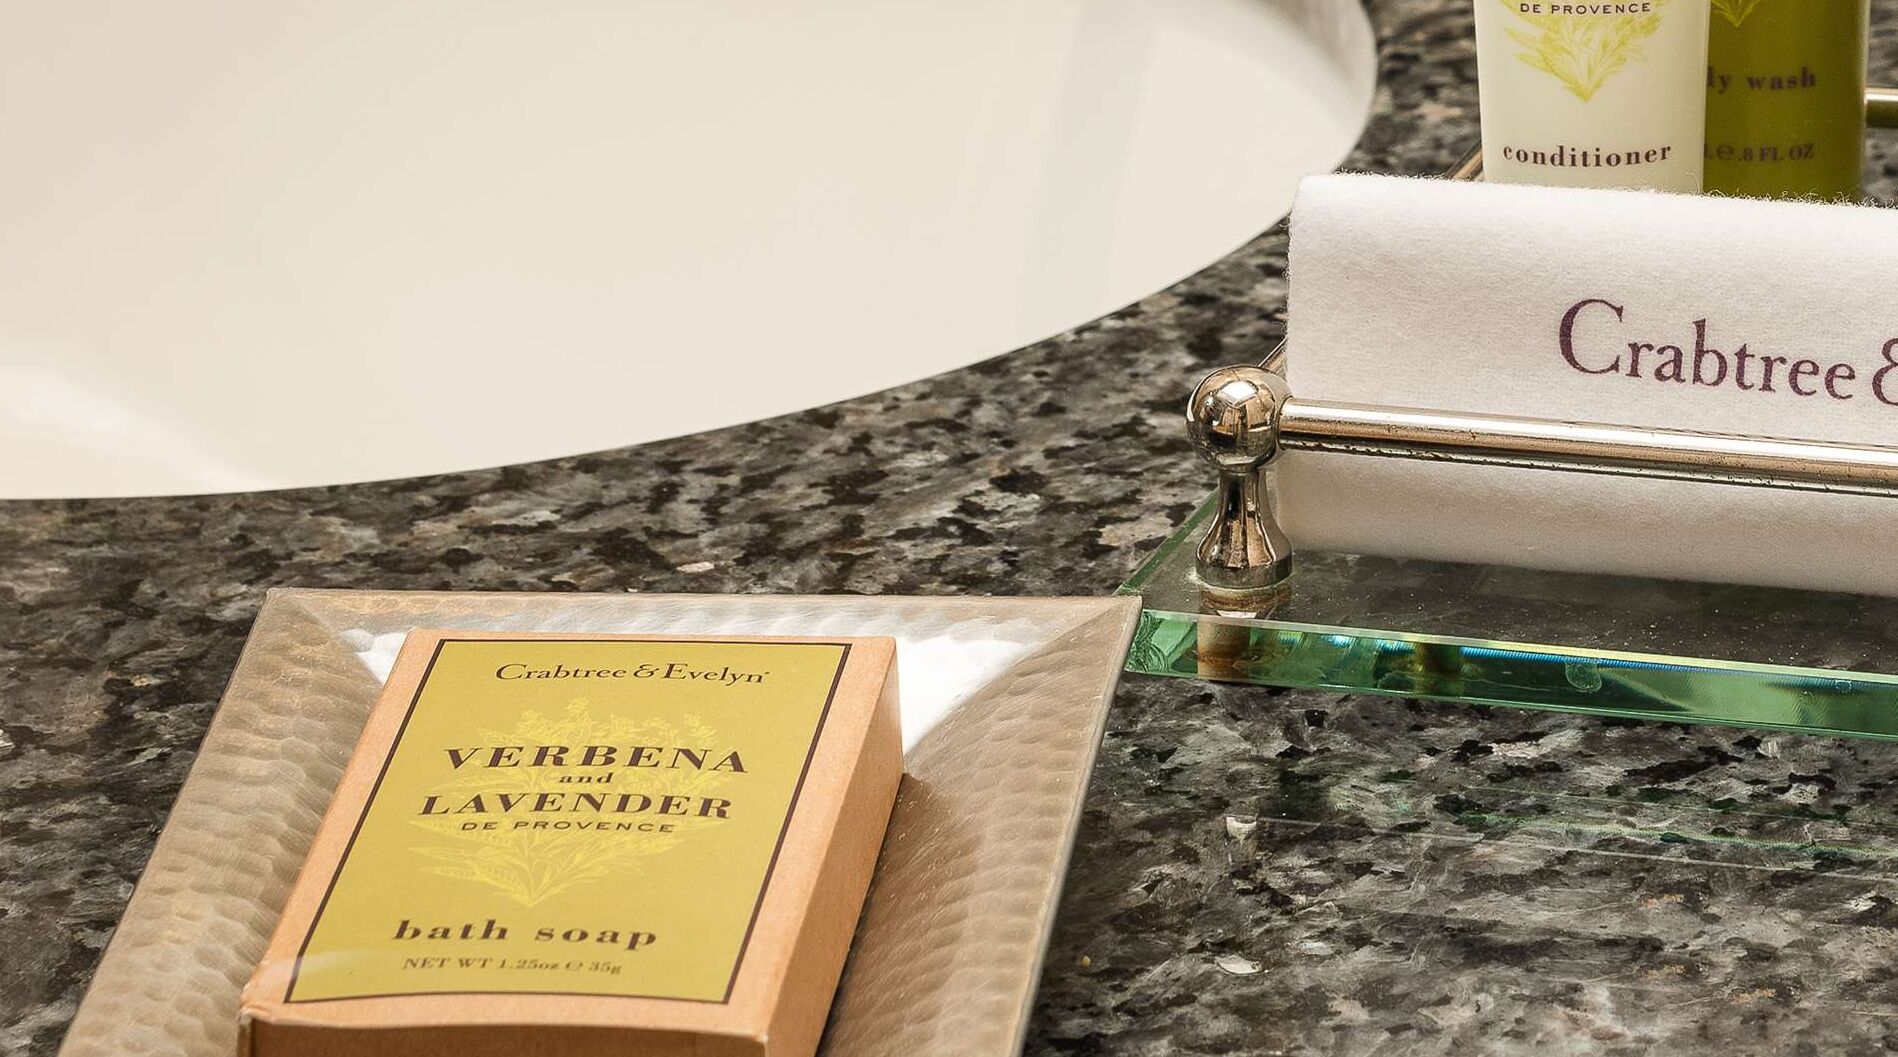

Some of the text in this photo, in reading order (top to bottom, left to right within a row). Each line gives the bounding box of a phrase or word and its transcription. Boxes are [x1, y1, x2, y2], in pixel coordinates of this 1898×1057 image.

[1520, 2, 1651, 15] DE PROVENCE
[1745, 66, 1816, 90] wash
[1503, 143, 1671, 170] conditioner
[1558, 297, 1857, 402] Crabtree
[495, 663, 627, 680] Crabtree
[633, 664, 660, 678] &
[443, 745, 748, 774] VERBENA
[558, 772, 614, 785] and
[417, 791, 733, 820] LAVENDER
[461, 820, 676, 833] DE PROVENCE
[391, 918, 657, 952] bath soap
[401, 957, 451, 970] NET
[457, 957, 493, 969] WT
